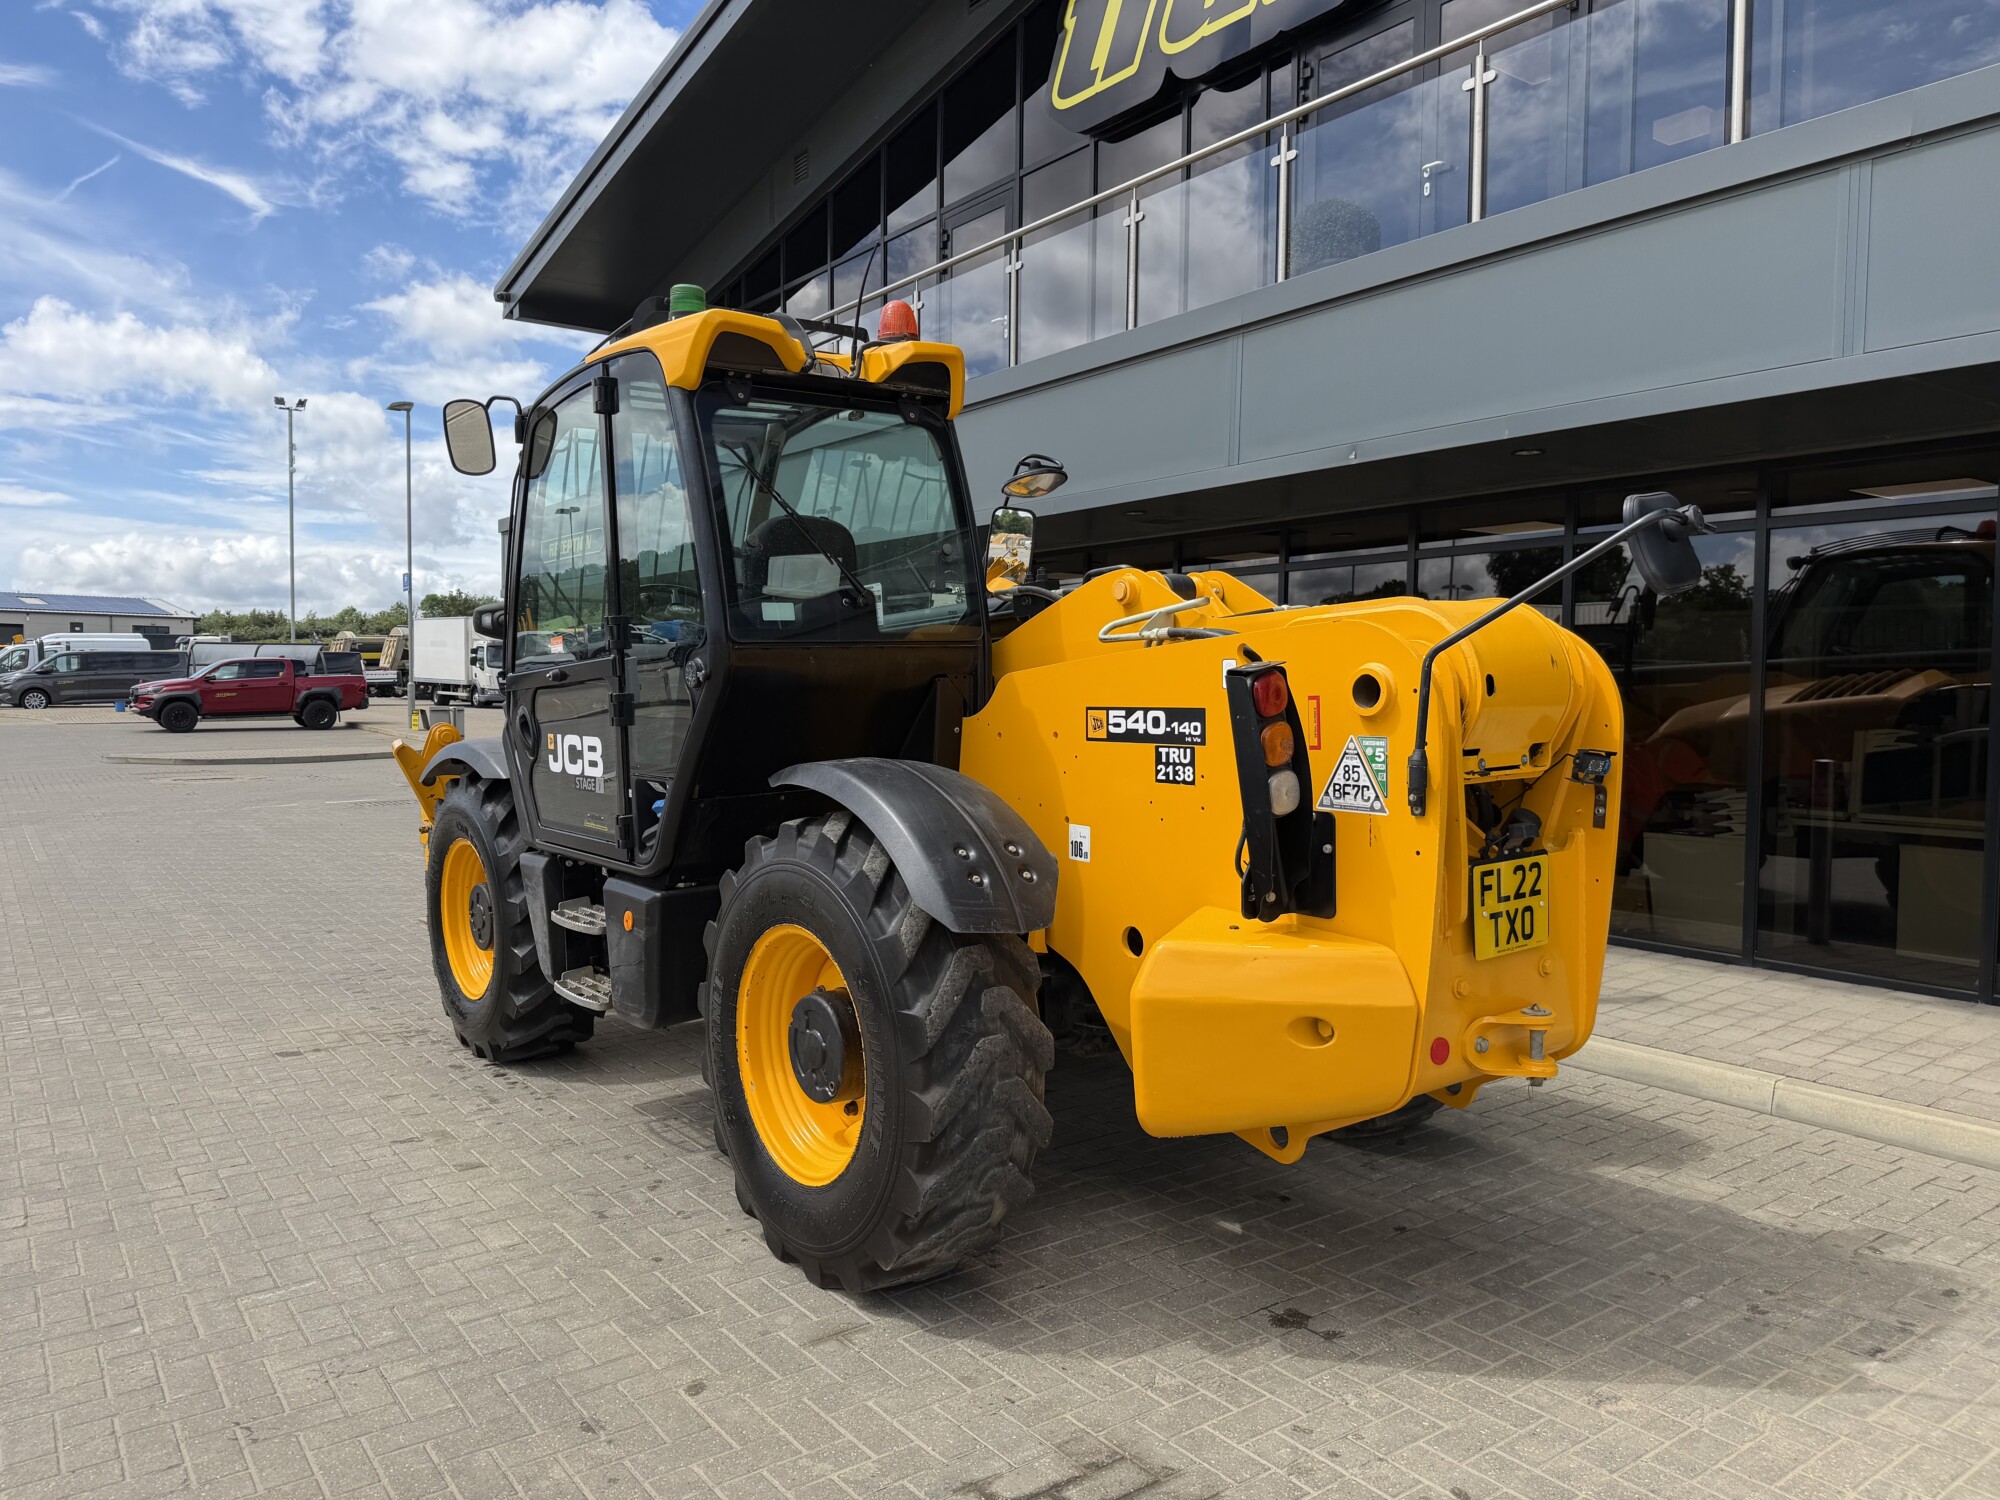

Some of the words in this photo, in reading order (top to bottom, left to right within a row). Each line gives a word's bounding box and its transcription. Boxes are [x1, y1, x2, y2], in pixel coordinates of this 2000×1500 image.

[1108, 710, 1202, 735] 540-140
[548, 734, 604, 777] JCB
[1158, 747, 1191, 764] TRU
[1374, 747, 1385, 762] 5
[1156, 764, 1194, 782] 2138
[1342, 764, 1361, 783] 85
[575, 776, 596, 791] STAGE
[1332, 782, 1371, 803] BF7C
[1071, 840, 1084, 858] 106
[1480, 861, 1541, 907] FL22
[1489, 905, 1534, 948] TXO
